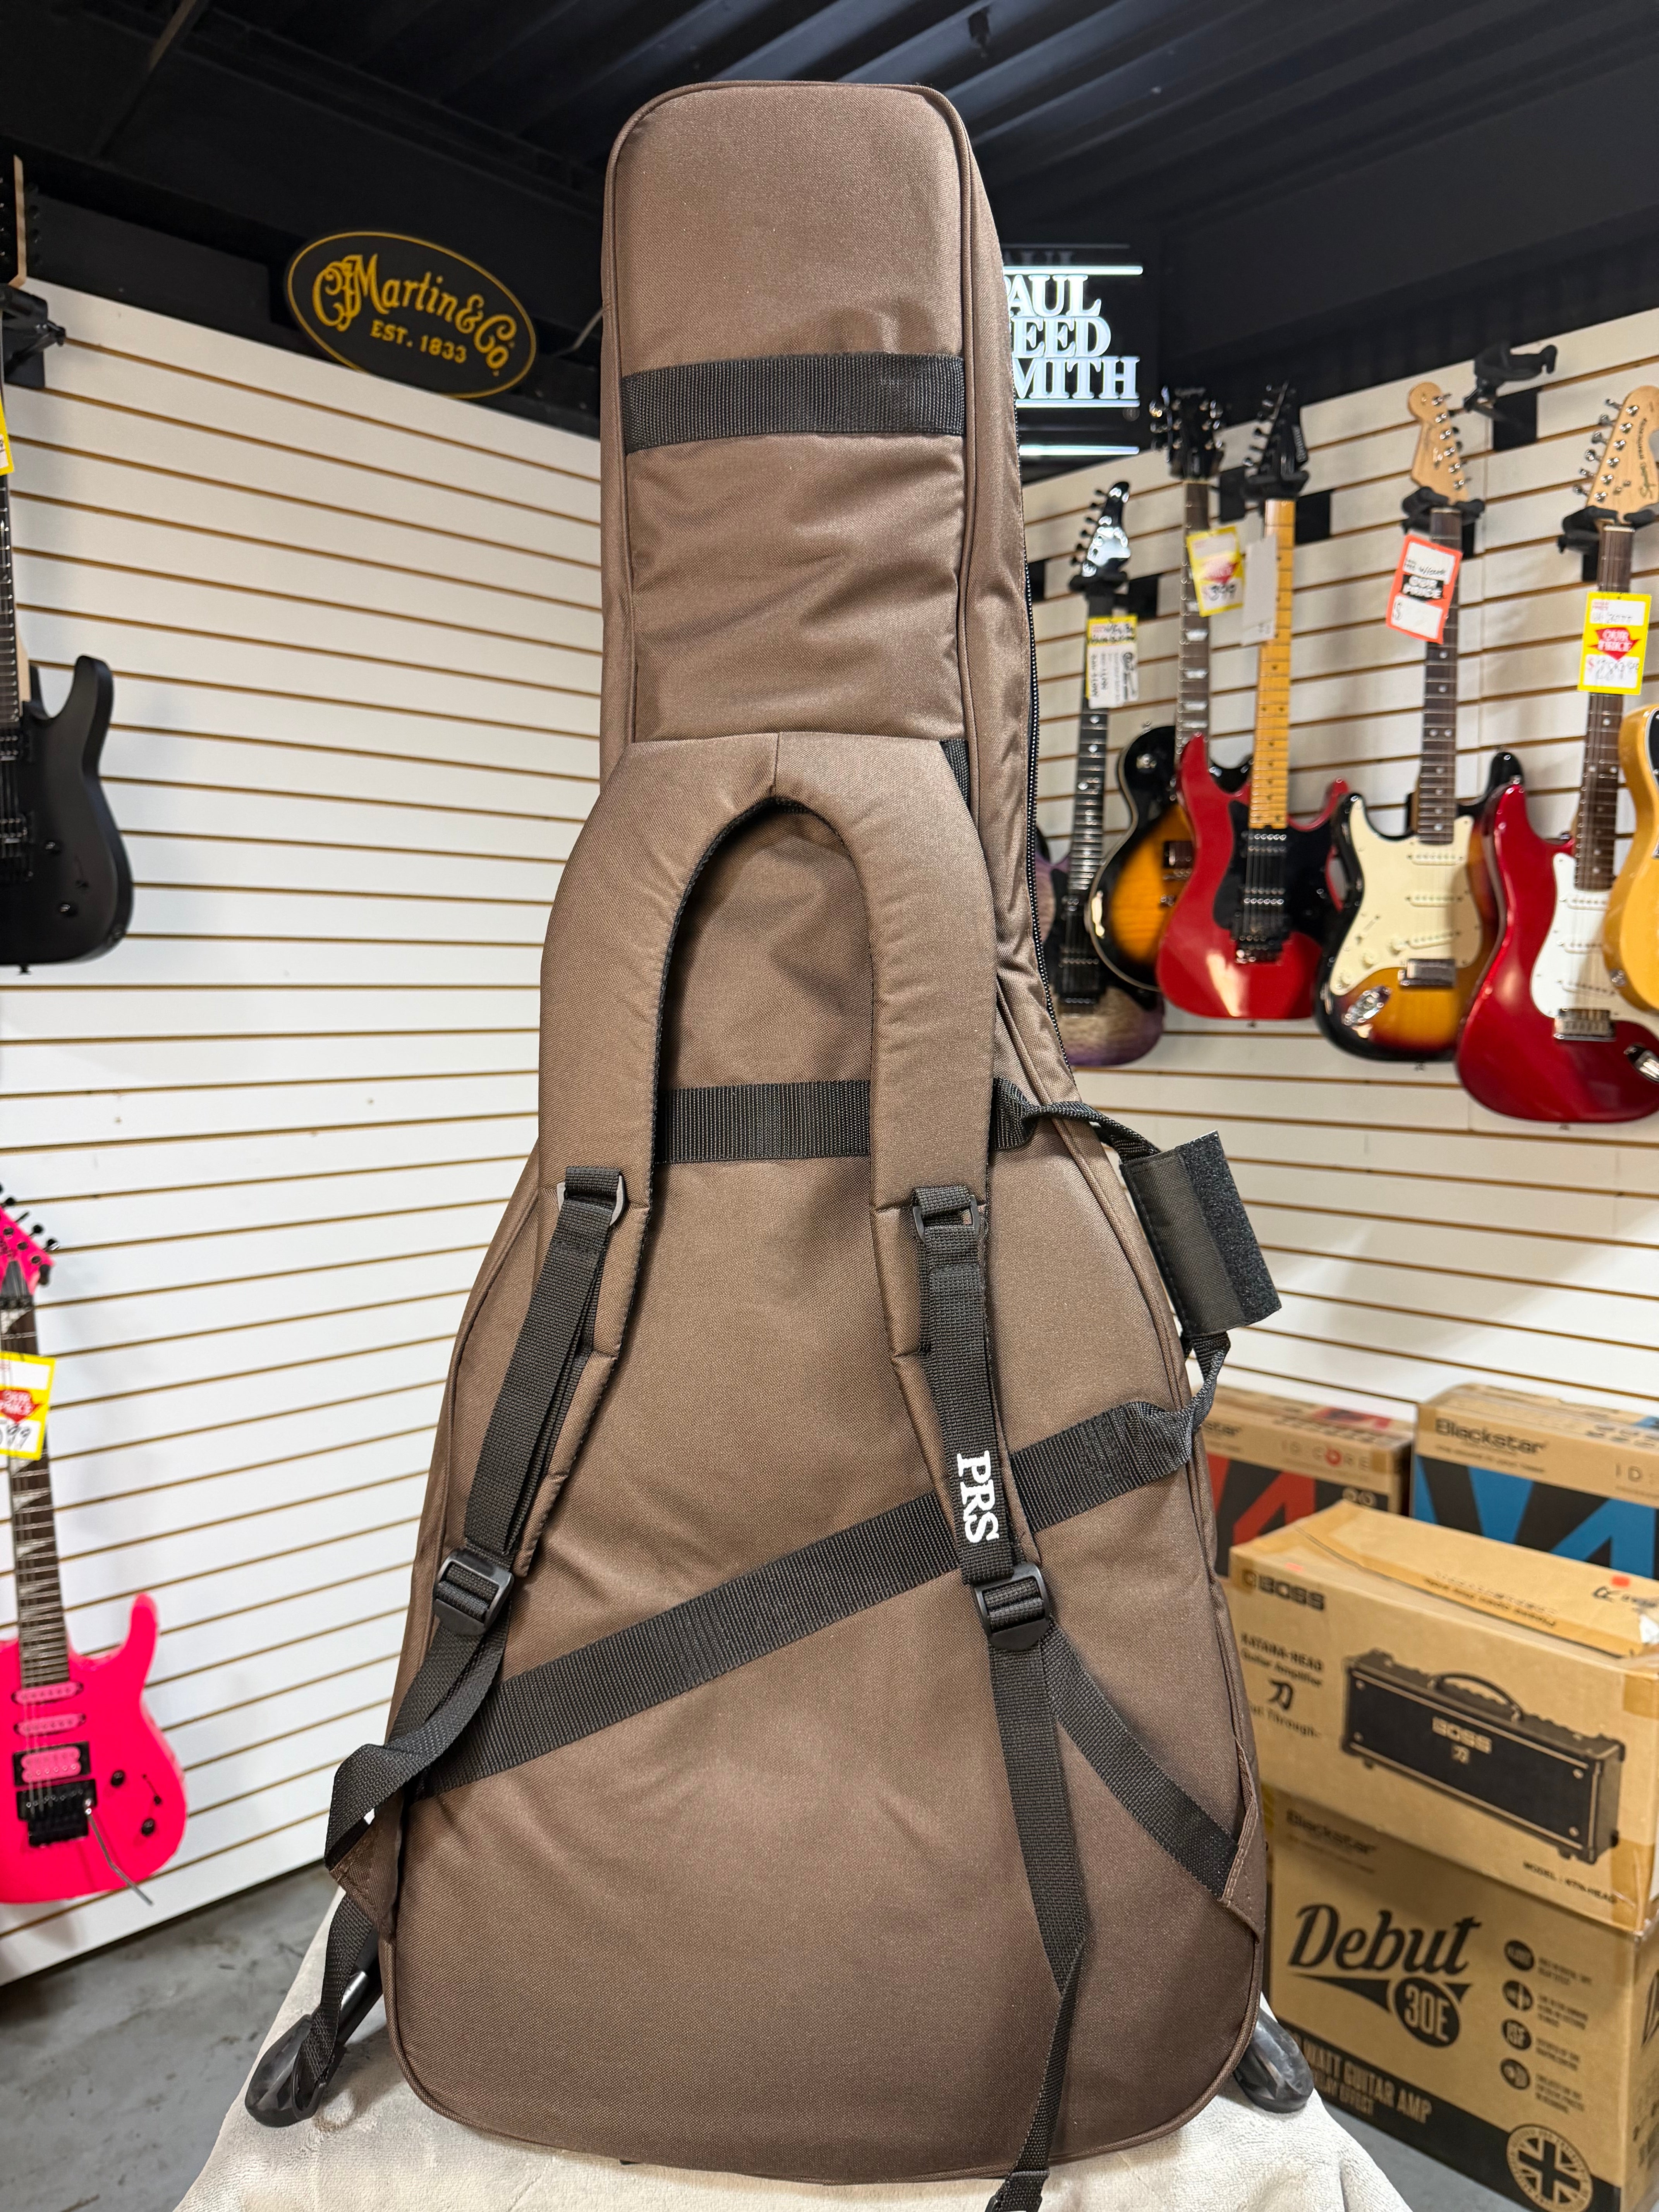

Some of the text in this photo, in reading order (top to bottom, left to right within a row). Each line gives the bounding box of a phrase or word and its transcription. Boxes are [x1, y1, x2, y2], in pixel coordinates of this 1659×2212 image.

[370, 319, 467, 364] EST. 1833
[1009, 316, 1111, 358] EED
[1012, 356, 1140, 399] MITH
[1435, 1417, 1546, 1454] Blackstar
[957, 1449, 1000, 1543] PRS
[1258, 1575, 1325, 1611] BOSS
[1432, 1716, 1492, 1755] BOSS
[1288, 1903, 1482, 1975] Debut
[1404, 1983, 1450, 2044] 30E
[1343, 2060, 1395, 2108] GUITAR
[1397, 2088, 1432, 2124] AMP
